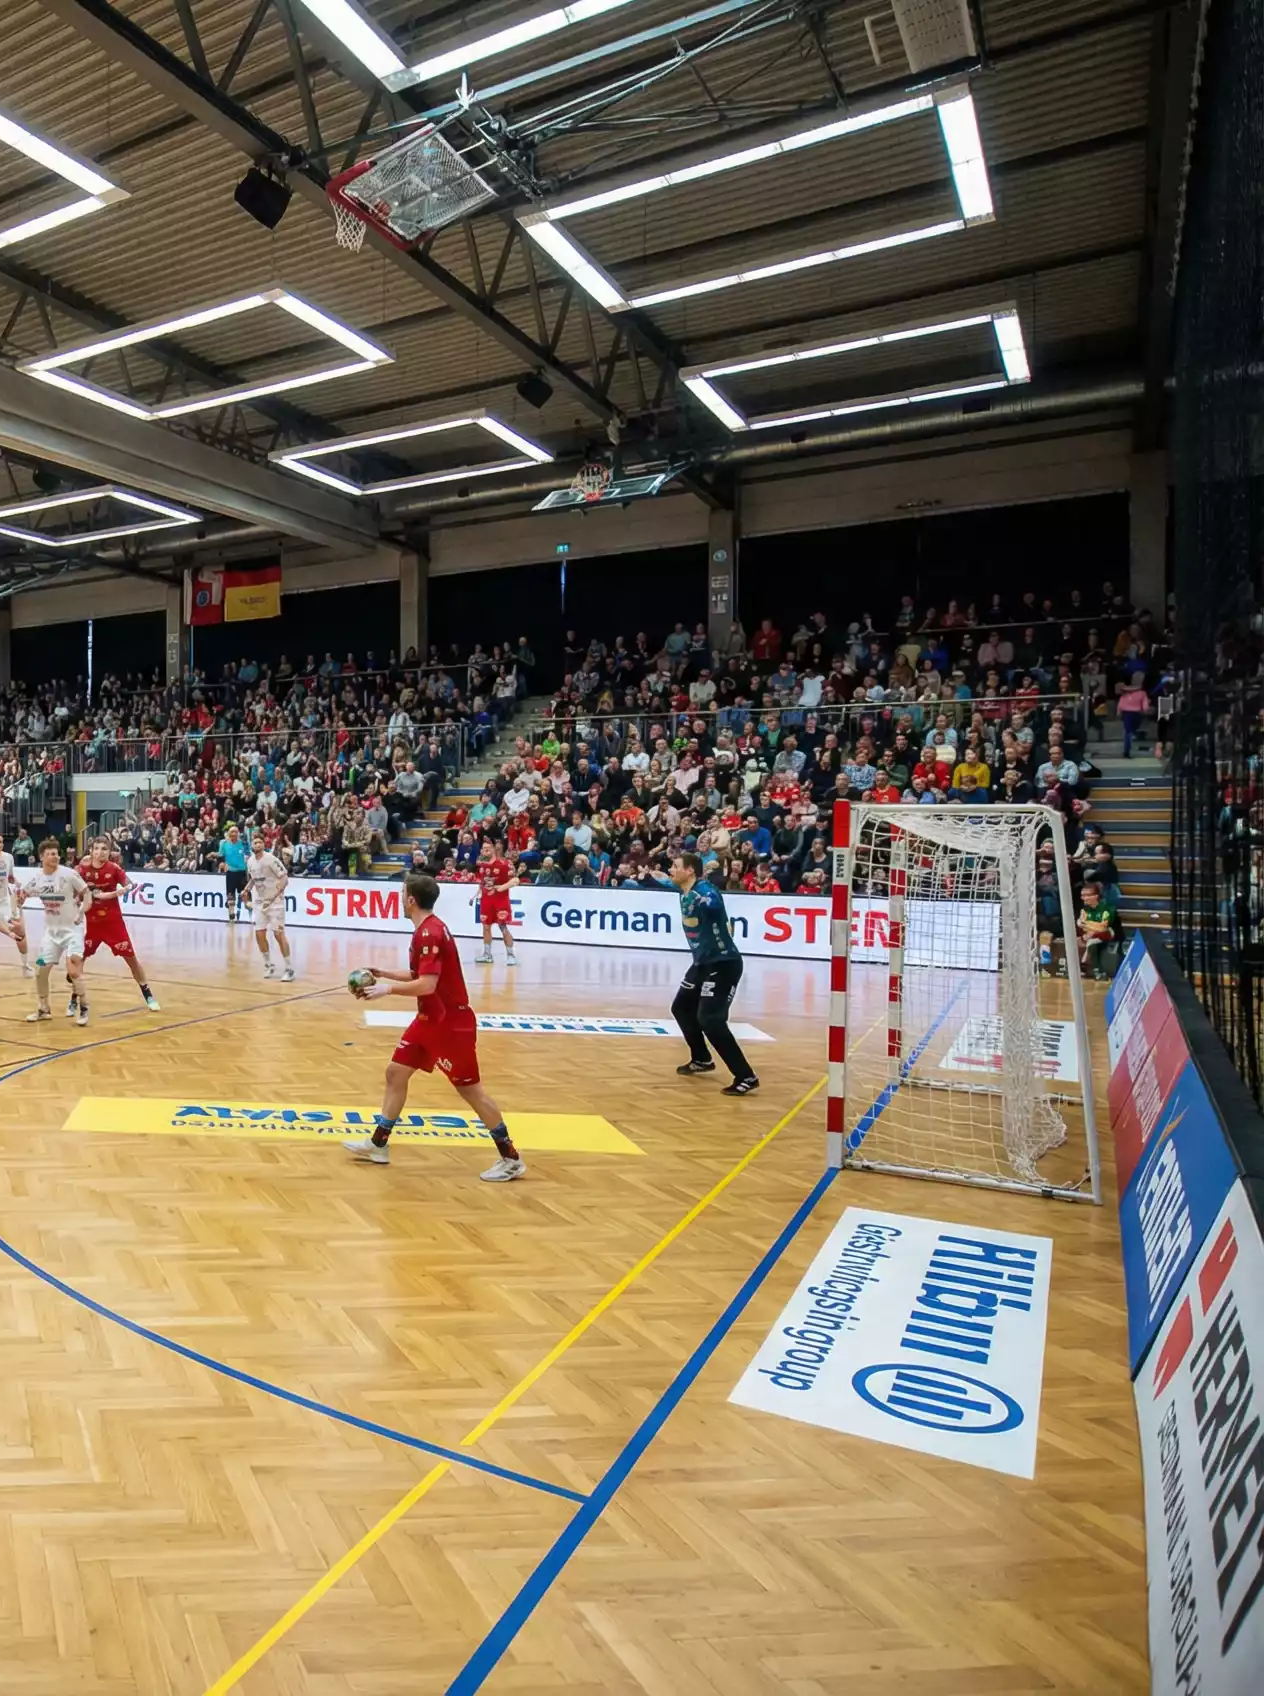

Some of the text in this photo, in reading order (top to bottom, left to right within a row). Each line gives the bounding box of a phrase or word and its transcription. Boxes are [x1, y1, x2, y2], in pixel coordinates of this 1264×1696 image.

[165, 885, 225, 909] Germ
[306, 887, 400, 920] STRM
[540, 900, 672, 934] German
